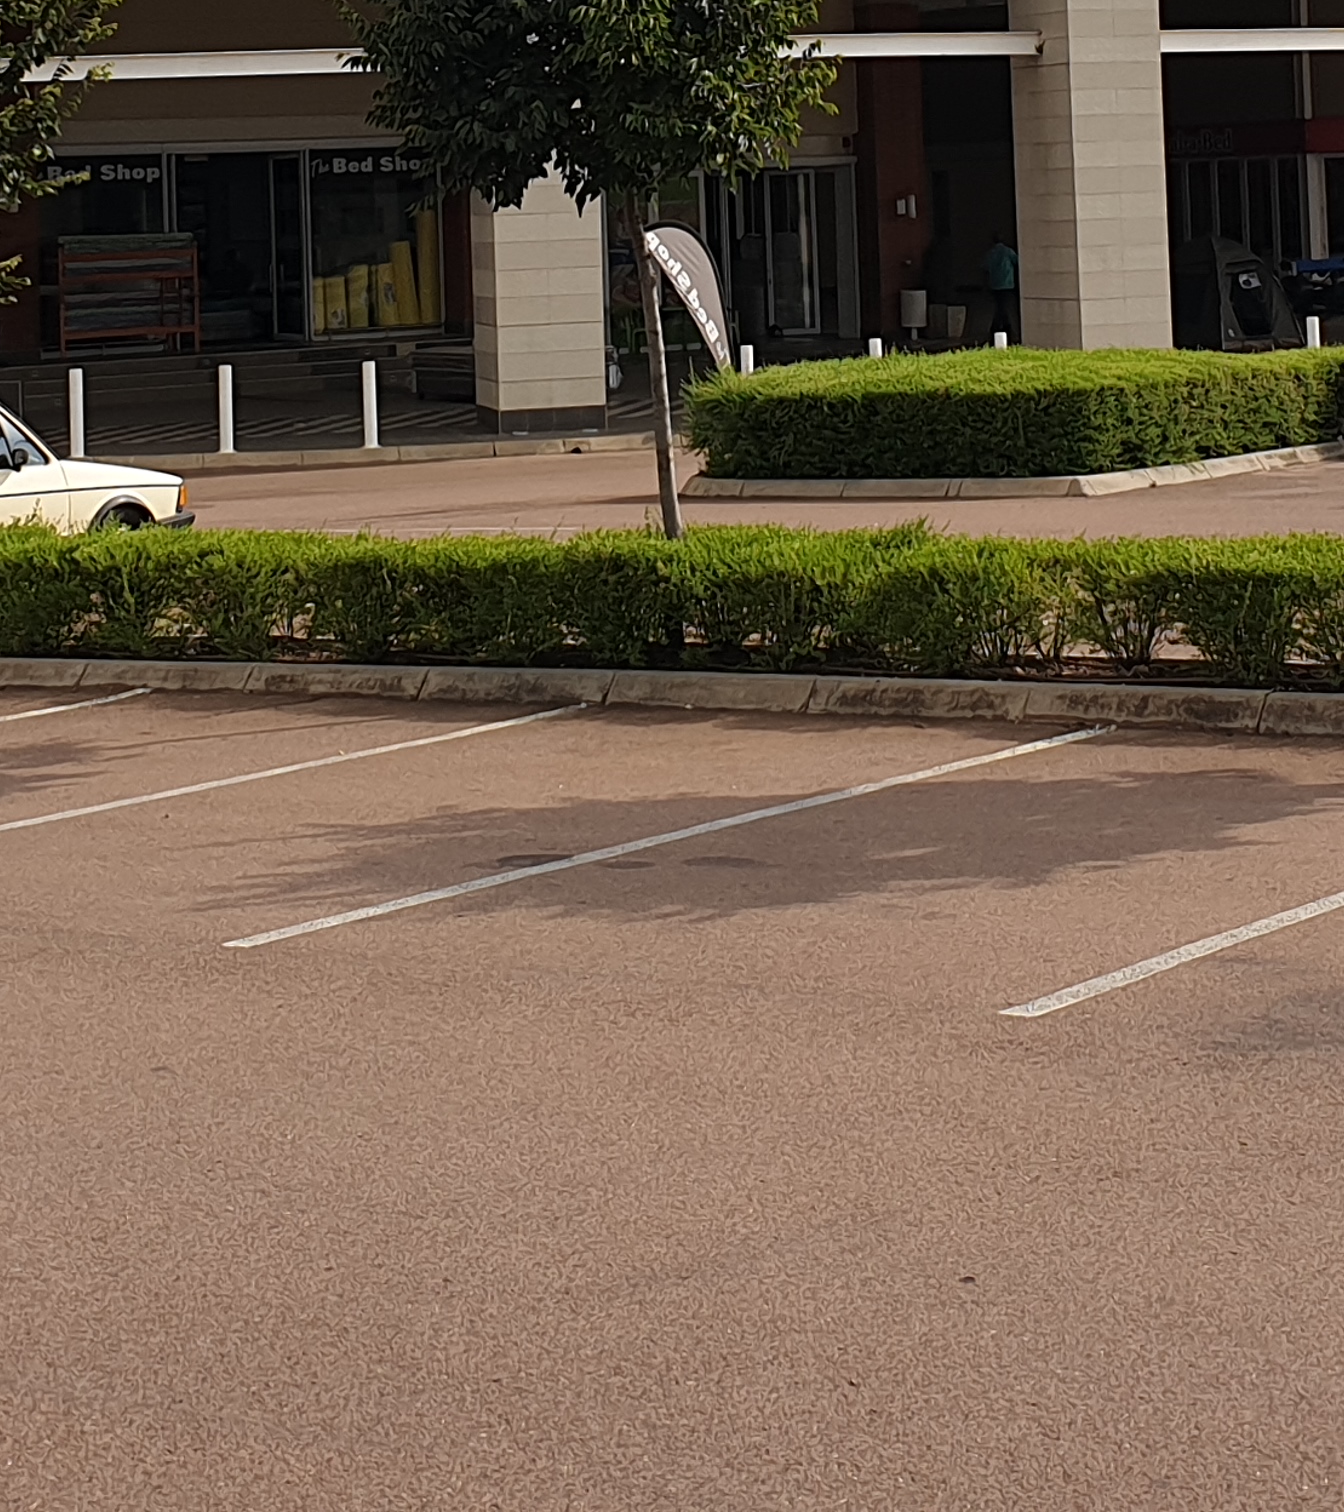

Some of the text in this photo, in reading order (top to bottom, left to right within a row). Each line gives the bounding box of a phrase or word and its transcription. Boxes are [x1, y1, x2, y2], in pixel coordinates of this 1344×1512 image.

[99, 163, 161, 183] Shop
[332, 156, 373, 175] Bed
[379, 155, 422, 173] Sho
